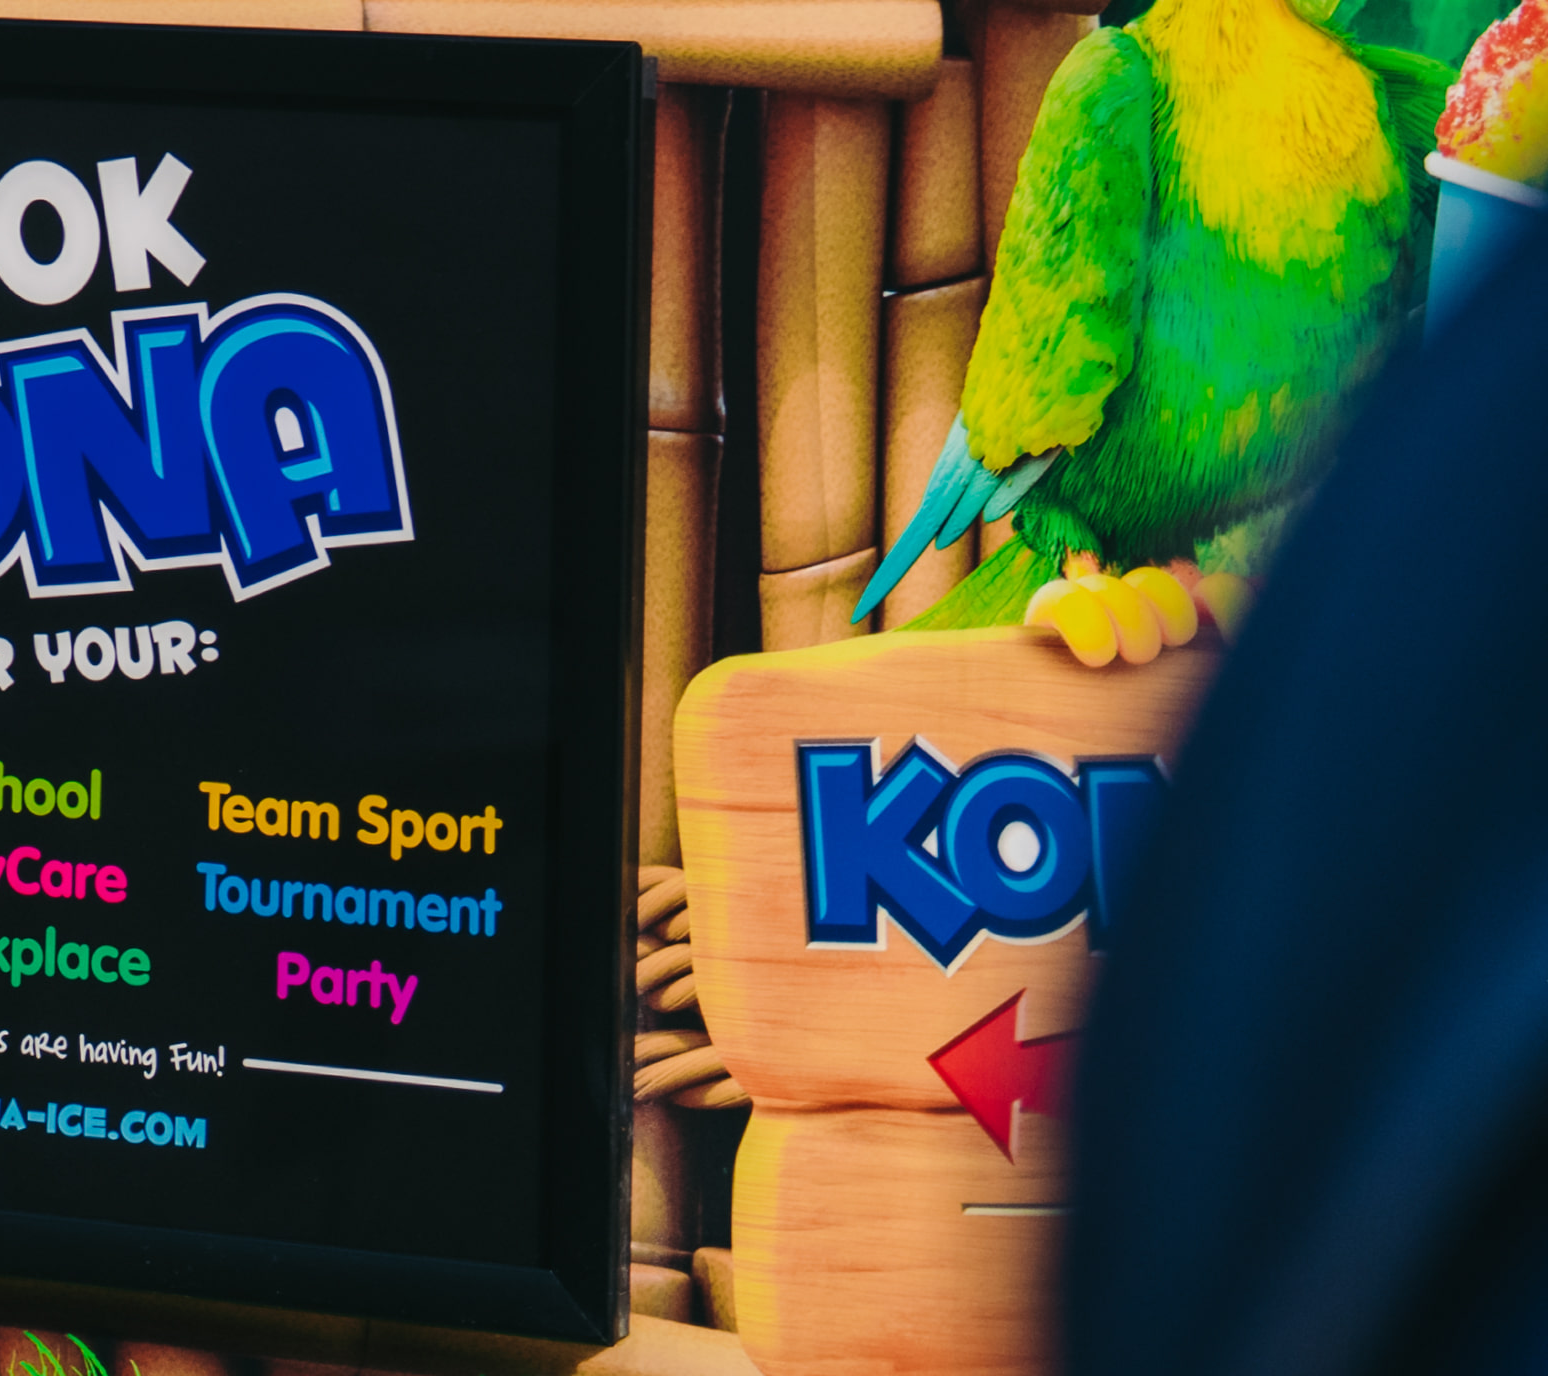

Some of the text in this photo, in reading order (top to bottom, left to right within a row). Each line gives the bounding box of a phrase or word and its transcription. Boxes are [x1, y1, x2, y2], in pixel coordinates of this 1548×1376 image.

[33, 620, 220, 684] YOUR:
[198, 781, 503, 861] Team Sport
[196, 862, 503, 937] Tournament
[276, 951, 418, 1026] Party
[79, 1033, 158, 1080] having
